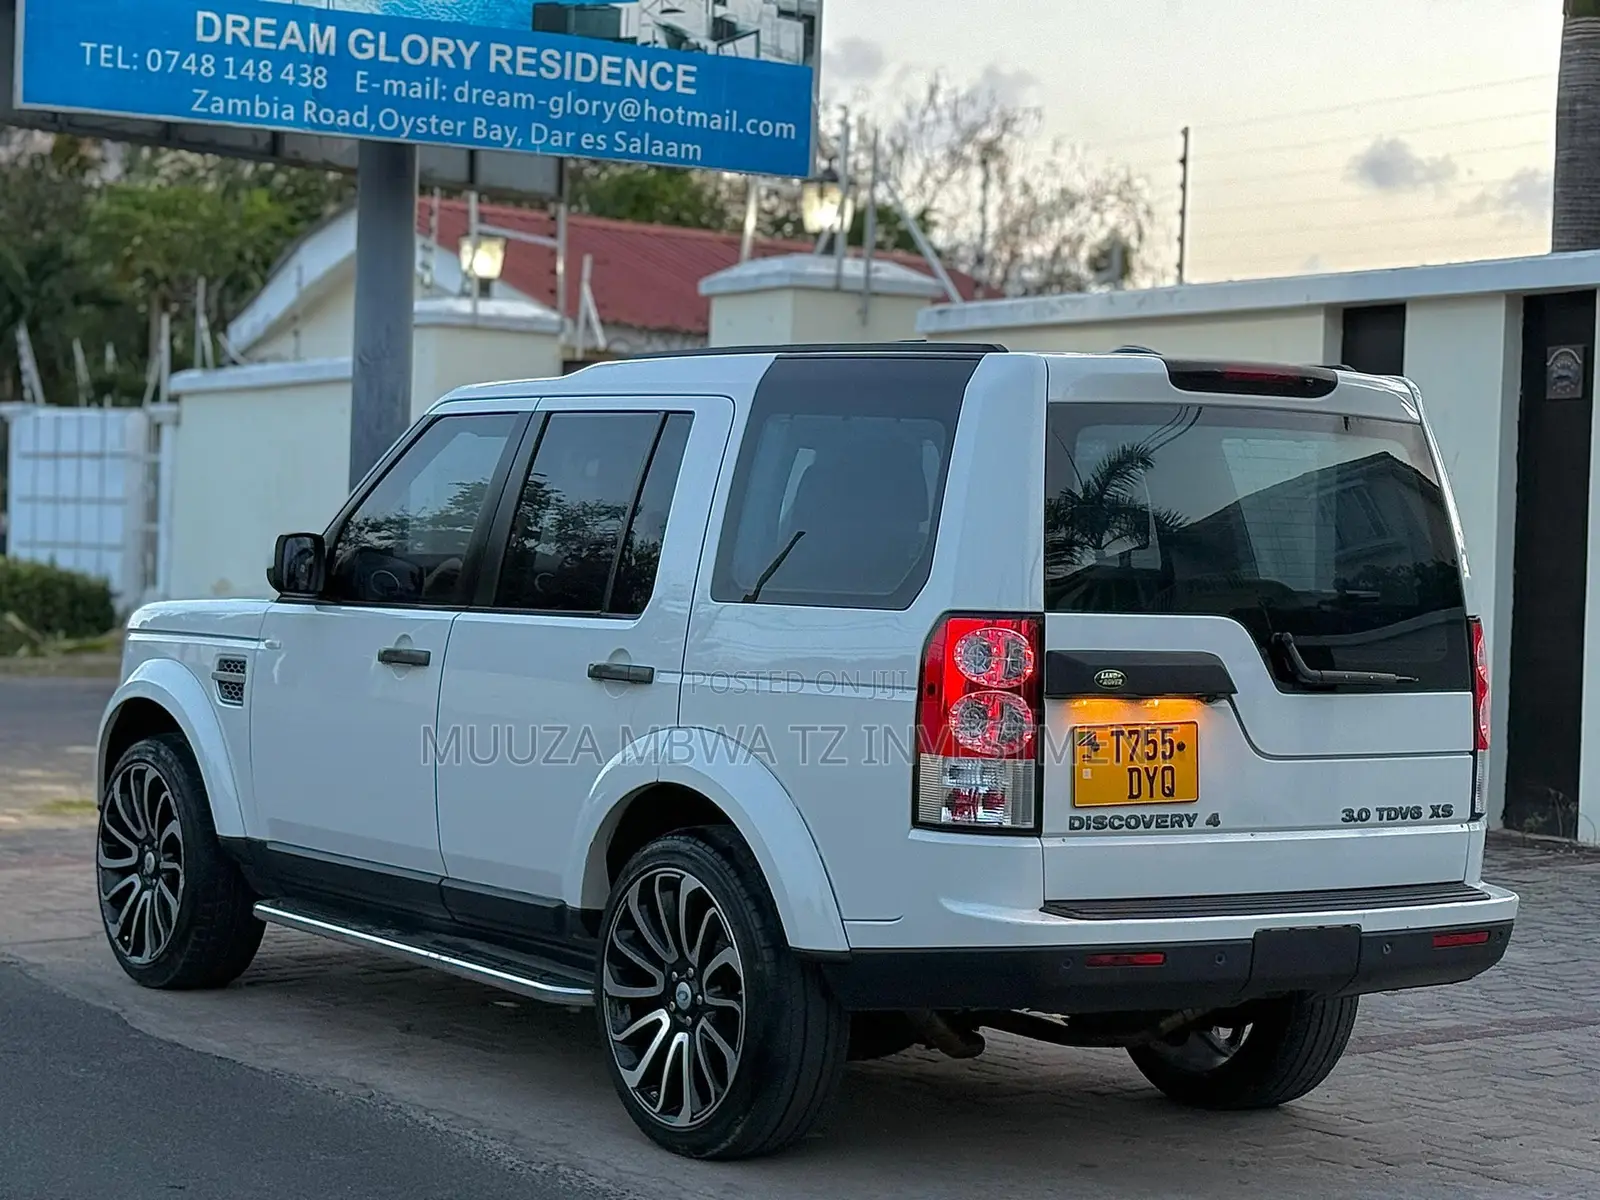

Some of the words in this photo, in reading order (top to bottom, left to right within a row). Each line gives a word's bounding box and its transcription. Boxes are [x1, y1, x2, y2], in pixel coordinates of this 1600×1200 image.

[80, 42, 138, 71] TEL:
[146, 48, 216, 77] 0748
[224, 57, 273, 83] 148
[280, 62, 328, 89] 438
[196, 10, 336, 56] DREAM
[347, 28, 479, 71] GLORY
[489, 43, 698, 95] RESIDENCE
[191, 89, 294, 121] Zambia
[473, 117, 523, 148] Bay,
[531, 122, 574, 149] Dar
[581, 133, 606, 151] es
[614, 131, 702, 161] Salaam
[1110, 728, 1175, 763] T755
[1127, 765, 1175, 800] DYQ
[1069, 812, 1198, 831] DISCOVERY
[1205, 812, 1221, 828] 4
[1341, 807, 1371, 822] 3.0
[1376, 805, 1423, 822] TDV6
[1428, 803, 1454, 819] XS
